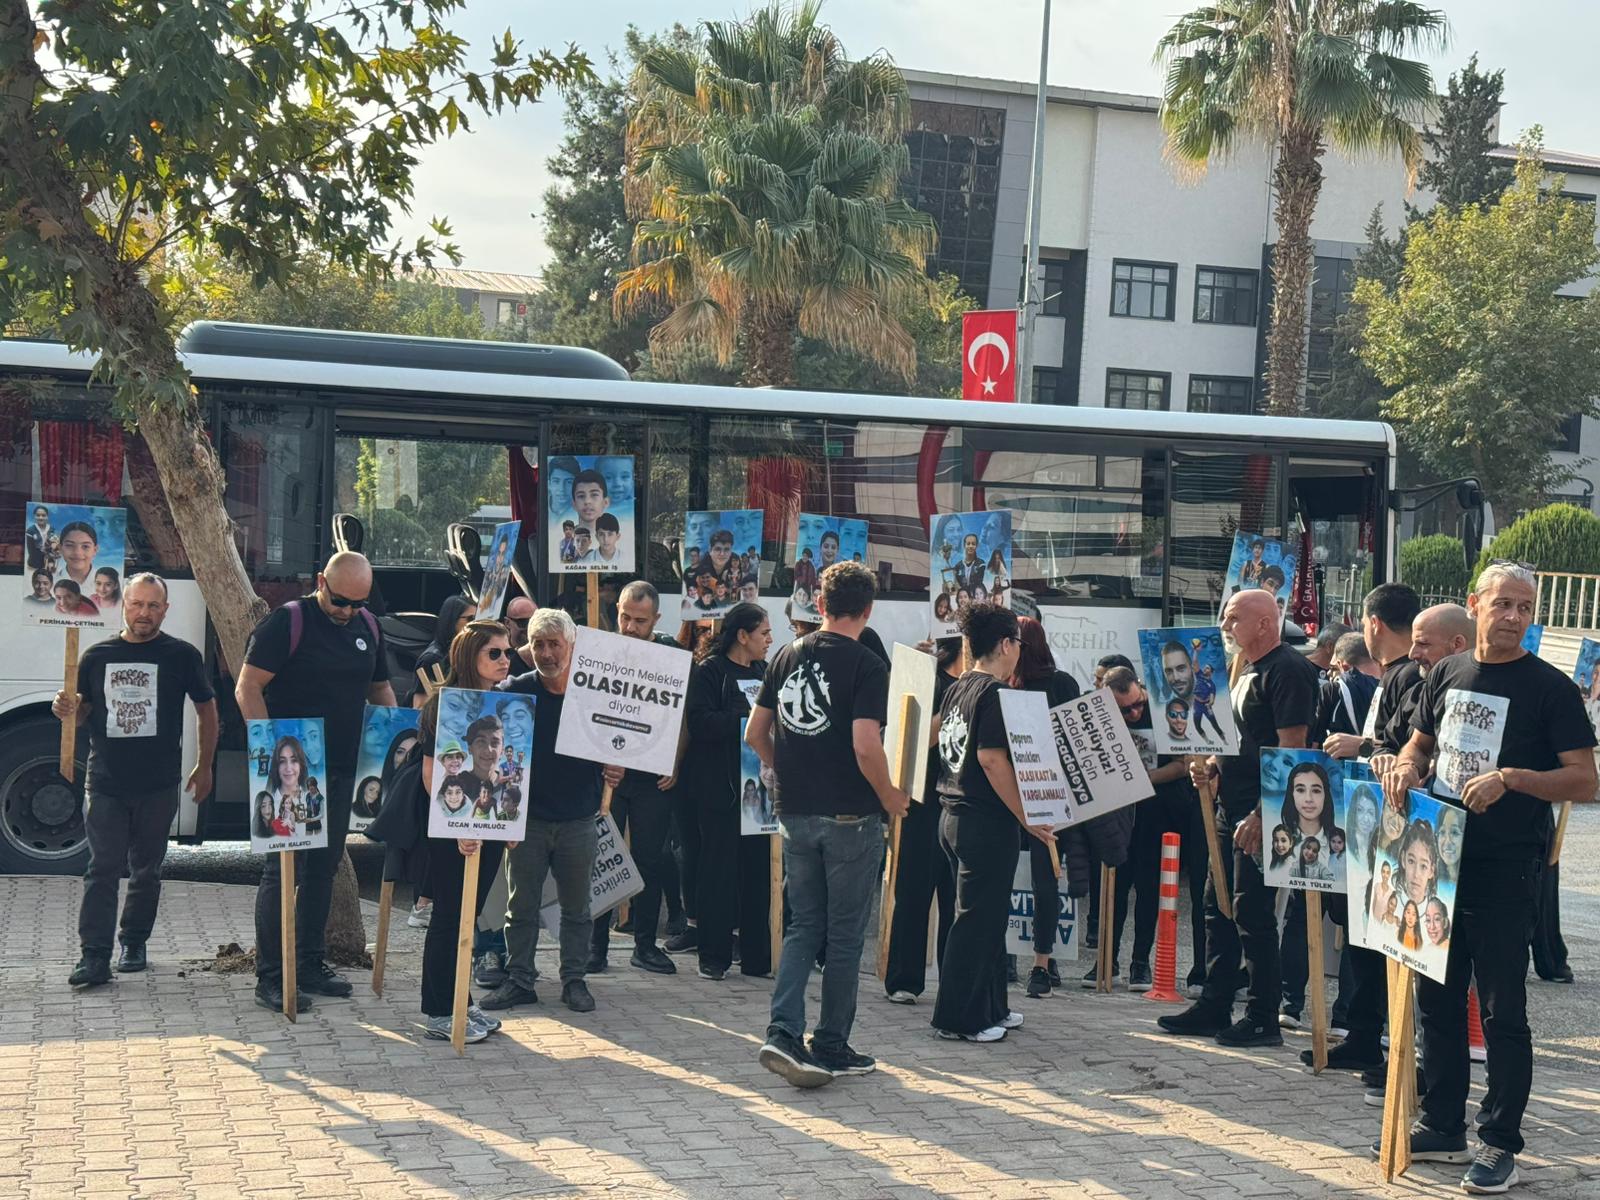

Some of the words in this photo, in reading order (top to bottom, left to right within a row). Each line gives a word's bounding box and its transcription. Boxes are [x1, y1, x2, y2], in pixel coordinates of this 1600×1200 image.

[1047, 630, 1121, 653] KŞEHİR
[577, 655, 635, 677] Şampiyon
[637, 669, 685, 688] Melekler
[573, 671, 629, 698] OLASI
[631, 683, 683, 709] KAST
[608, 699, 641, 716] diyor!
[1061, 708, 1087, 753] Adalet
[1077, 701, 1116, 775] Güçlüyüz!
[1091, 695, 1116, 741] Birlikte
[1111, 742, 1134, 781] Daha
[447, 820, 469, 828] İZCAN
[593, 867, 631, 896] Birlikte
[1289, 879, 1307, 887] ASYA
[1310, 881, 1333, 889] TÜLEK
